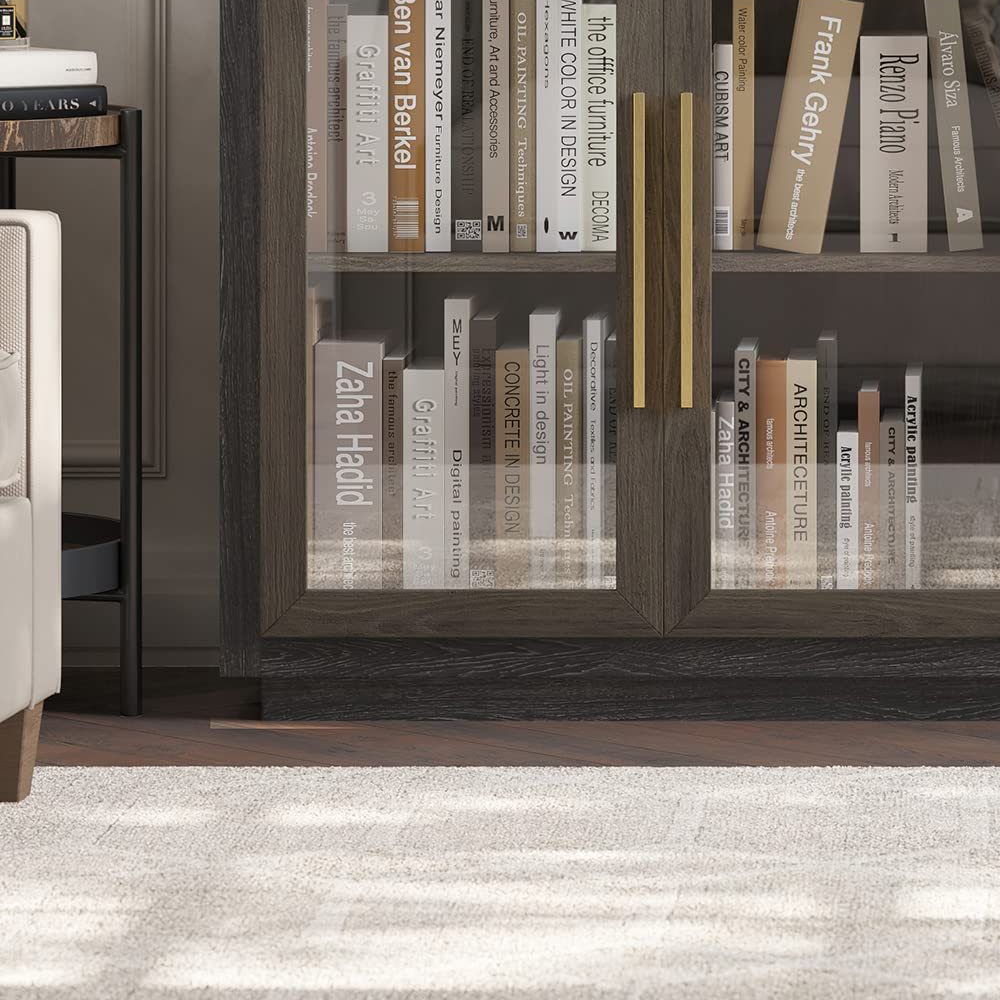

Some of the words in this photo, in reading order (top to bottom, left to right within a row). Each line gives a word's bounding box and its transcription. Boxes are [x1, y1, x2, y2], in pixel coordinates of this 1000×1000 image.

[518, 11, 527, 42] OIL
[588, 16, 612, 42] the
[738, 7, 747, 34] Water
[394, 41, 411, 86] van
[490, 44, 500, 63] Art
[738, 35, 747, 56] color
[809, 14, 842, 85] Frank
[939, 30, 959, 77] Álvaro
[357, 44, 381, 124] Graffiti
[433, 26, 445, 122] Niemeyer
[490, 64, 500, 87] and
[518, 45, 527, 129] PAINTING
[561, 52, 576, 110] COLOR
[737, 58, 747, 92] Painting
[879, 52, 919, 103] Renzo
[944, 80, 960, 108] Siza
[21, 97, 80, 112] YEARS
[490, 88, 500, 159] Accessories
[561, 115, 576, 130] IN
[715, 70, 729, 131] CUBISM
[357, 132, 381, 166] Art
[394, 93, 416, 170] Berkel
[587, 99, 613, 167] furniture
[715, 131, 729, 162] ART
[790, 91, 827, 166] Gehry
[879, 108, 919, 154] Piano
[952, 124, 961, 156] Famous
[517, 136, 527, 218] Techniques
[561, 135, 576, 197] DESIGN
[795, 167, 806, 182] the
[888, 169, 904, 193] Modern
[954, 155, 965, 193] Architects
[434, 189, 442, 235] Design
[792, 182, 804, 201] best
[592, 190, 609, 243] DECOMA
[533, 344, 549, 385] Light
[563, 368, 573, 398] OIL
[590, 341, 598, 411] Decorative
[739, 357, 749, 396] CITY
[336, 360, 373, 425] Zaha
[504, 361, 520, 449] CONCRETE
[536, 390, 549, 405] in
[412, 399, 437, 479] Graffiti
[533, 410, 549, 465] design
[906, 395, 917, 442] Acrylic
[505, 453, 520, 469] IN
[563, 402, 573, 486] PAINTING
[839, 445, 852, 482] Acrylic
[336, 433, 373, 507] Hadid
[452, 449, 462, 504] Digital
[906, 445, 917, 504] painting
[412, 487, 436, 520] Art
[504, 473, 520, 533] DESIGN
[838, 484, 852, 529] painting
[450, 510, 462, 579] painting
